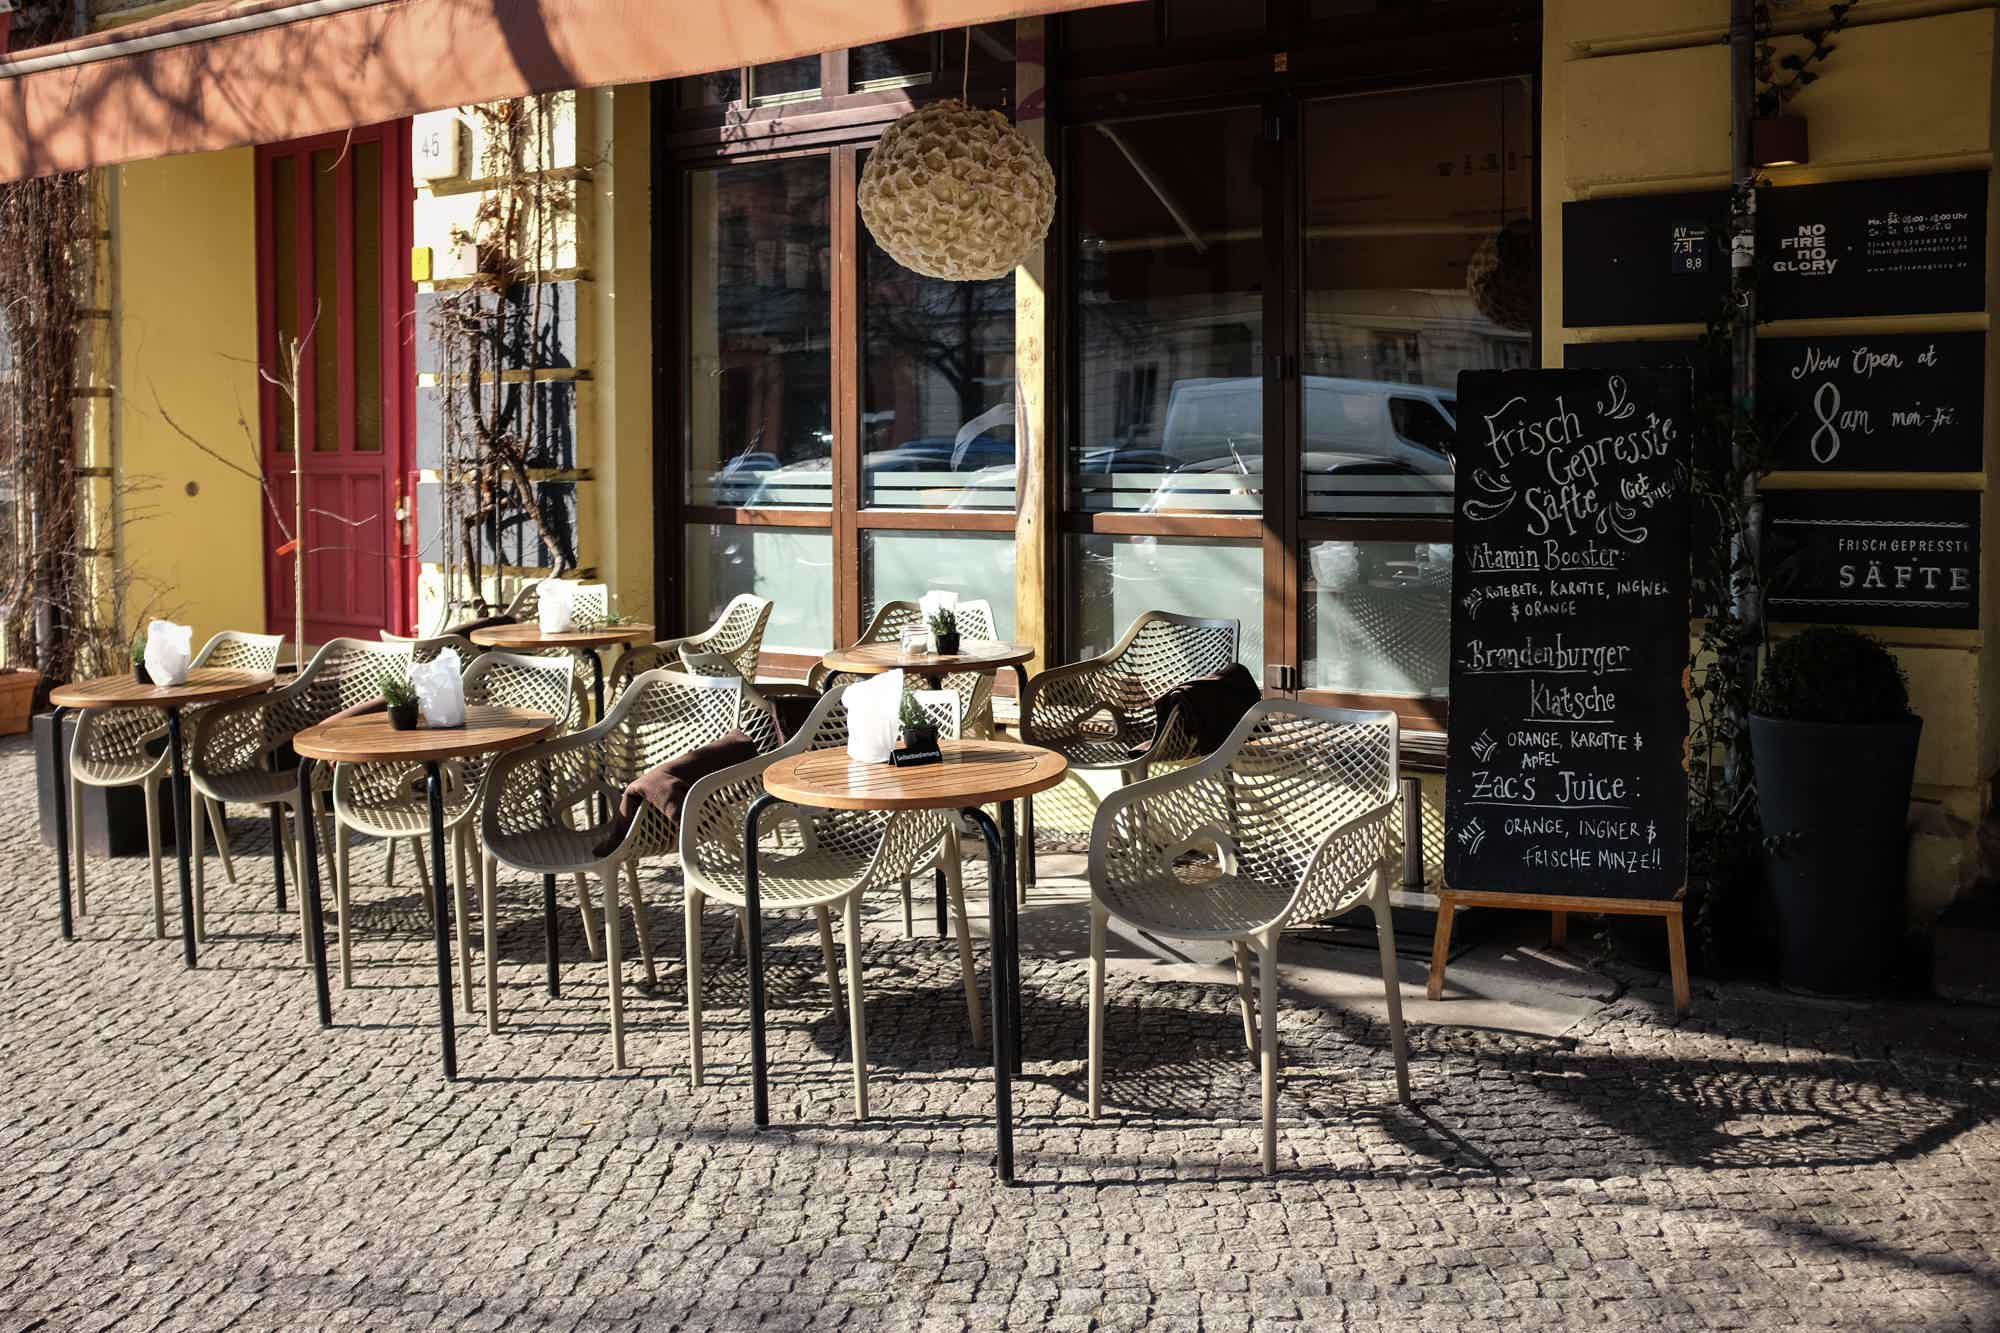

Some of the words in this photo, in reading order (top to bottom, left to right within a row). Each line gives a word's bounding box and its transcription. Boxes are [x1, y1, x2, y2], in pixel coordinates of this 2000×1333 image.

[1673, 226, 1687, 239] AV
[1781, 236, 1826, 249] FIRE
[1798, 223, 1826, 236] NO
[1772, 258, 1839, 275] GLORY
[1791, 346, 1840, 379] Now
[1852, 346, 1903, 379] Open
[1917, 344, 1938, 368] at
[1484, 396, 1583, 469] Frisch
[1547, 412, 1677, 487] Gepresste
[1525, 484, 1600, 536] Säfte
[1465, 542, 1540, 570] Vitamin
[1550, 580, 1610, 600] KAROTTE,
[1838, 560, 1971, 592] SÄFTE
[1525, 600, 1577, 617] ORANGE
[1467, 633, 1631, 675] Brandenburger
[1531, 679, 1616, 719] Klatsche
[1471, 729, 1497, 760] MIT
[1507, 731, 1563, 749] ORANGE,
[1571, 731, 1628, 751] KAROTTE
[1521, 752, 1560, 769] APFEL
[1472, 771, 1536, 801] Zac's
[1457, 817, 1483, 845] MIT
[1504, 816, 1570, 839] ORANGE,
[1579, 820, 1641, 840] INGWER
[1522, 845, 1592, 869] FRISCHE
[1598, 848, 1663, 873] MINZE!!
